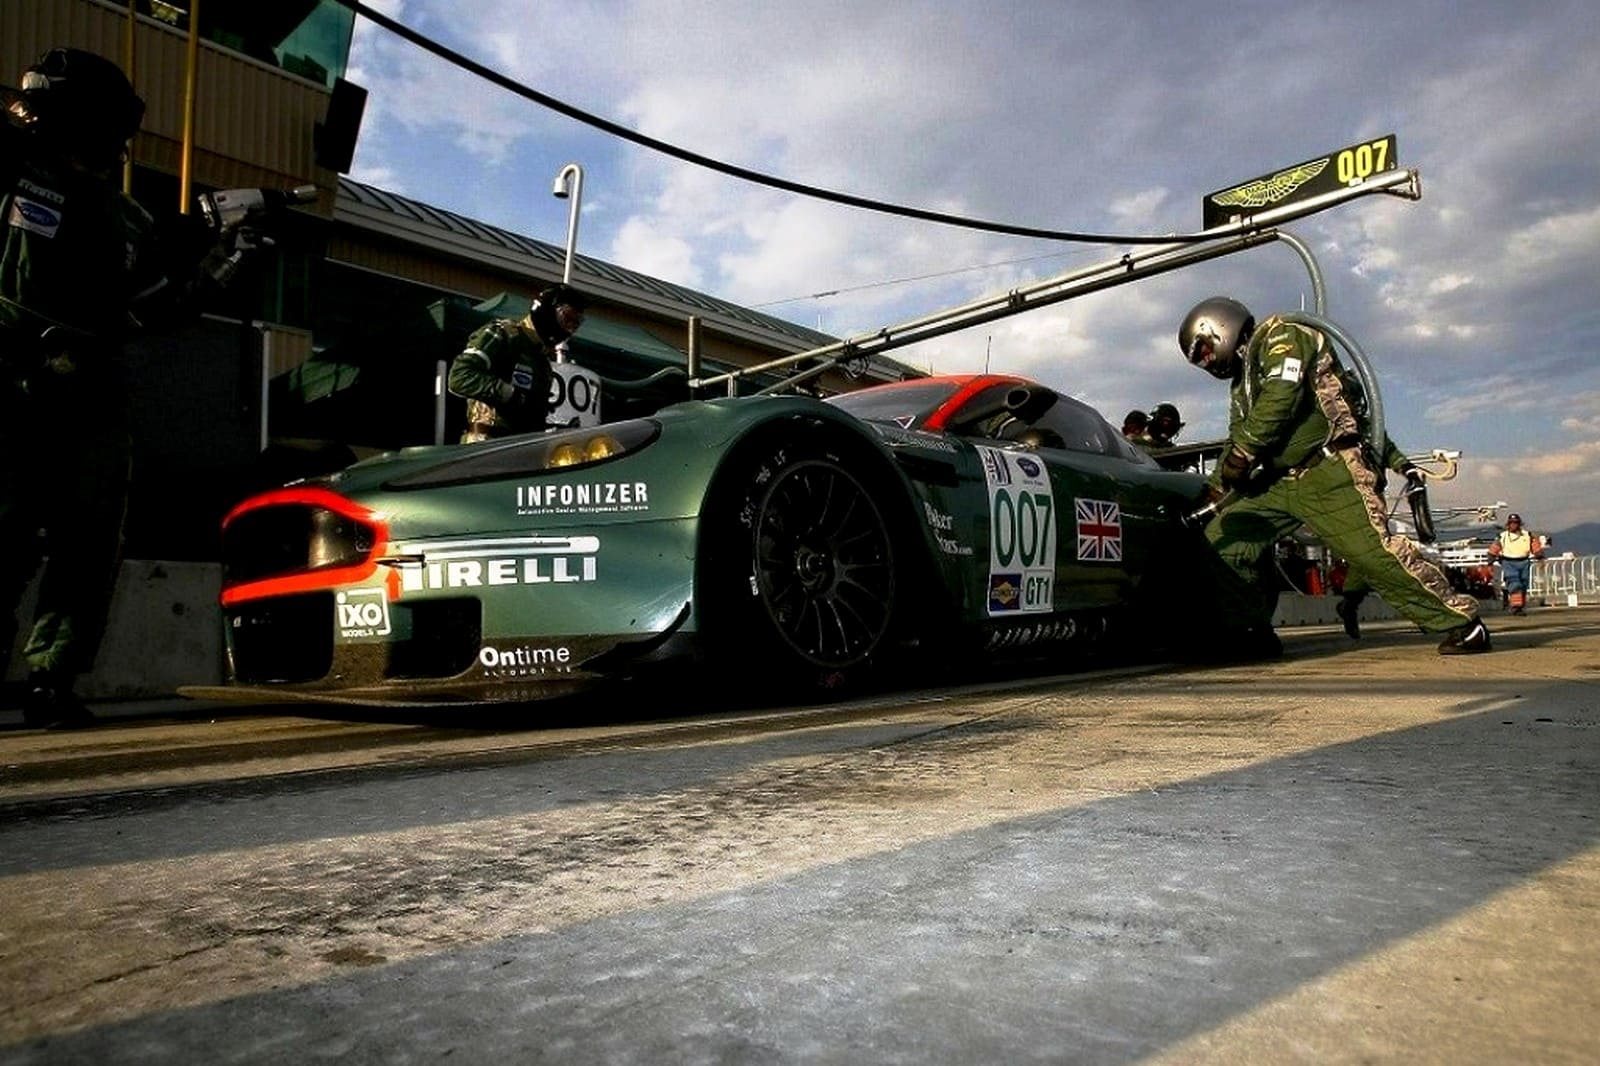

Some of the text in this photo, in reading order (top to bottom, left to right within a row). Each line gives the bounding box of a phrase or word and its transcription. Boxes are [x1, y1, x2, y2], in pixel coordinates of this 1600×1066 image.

[1337, 139, 1390, 185] 007
[517, 482, 648, 507] INFONIZER
[994, 487, 1052, 567] 007
[400, 535, 600, 591] PIRELLI
[1026, 576, 1050, 605] GT1
[480, 646, 570, 667] Ontime
